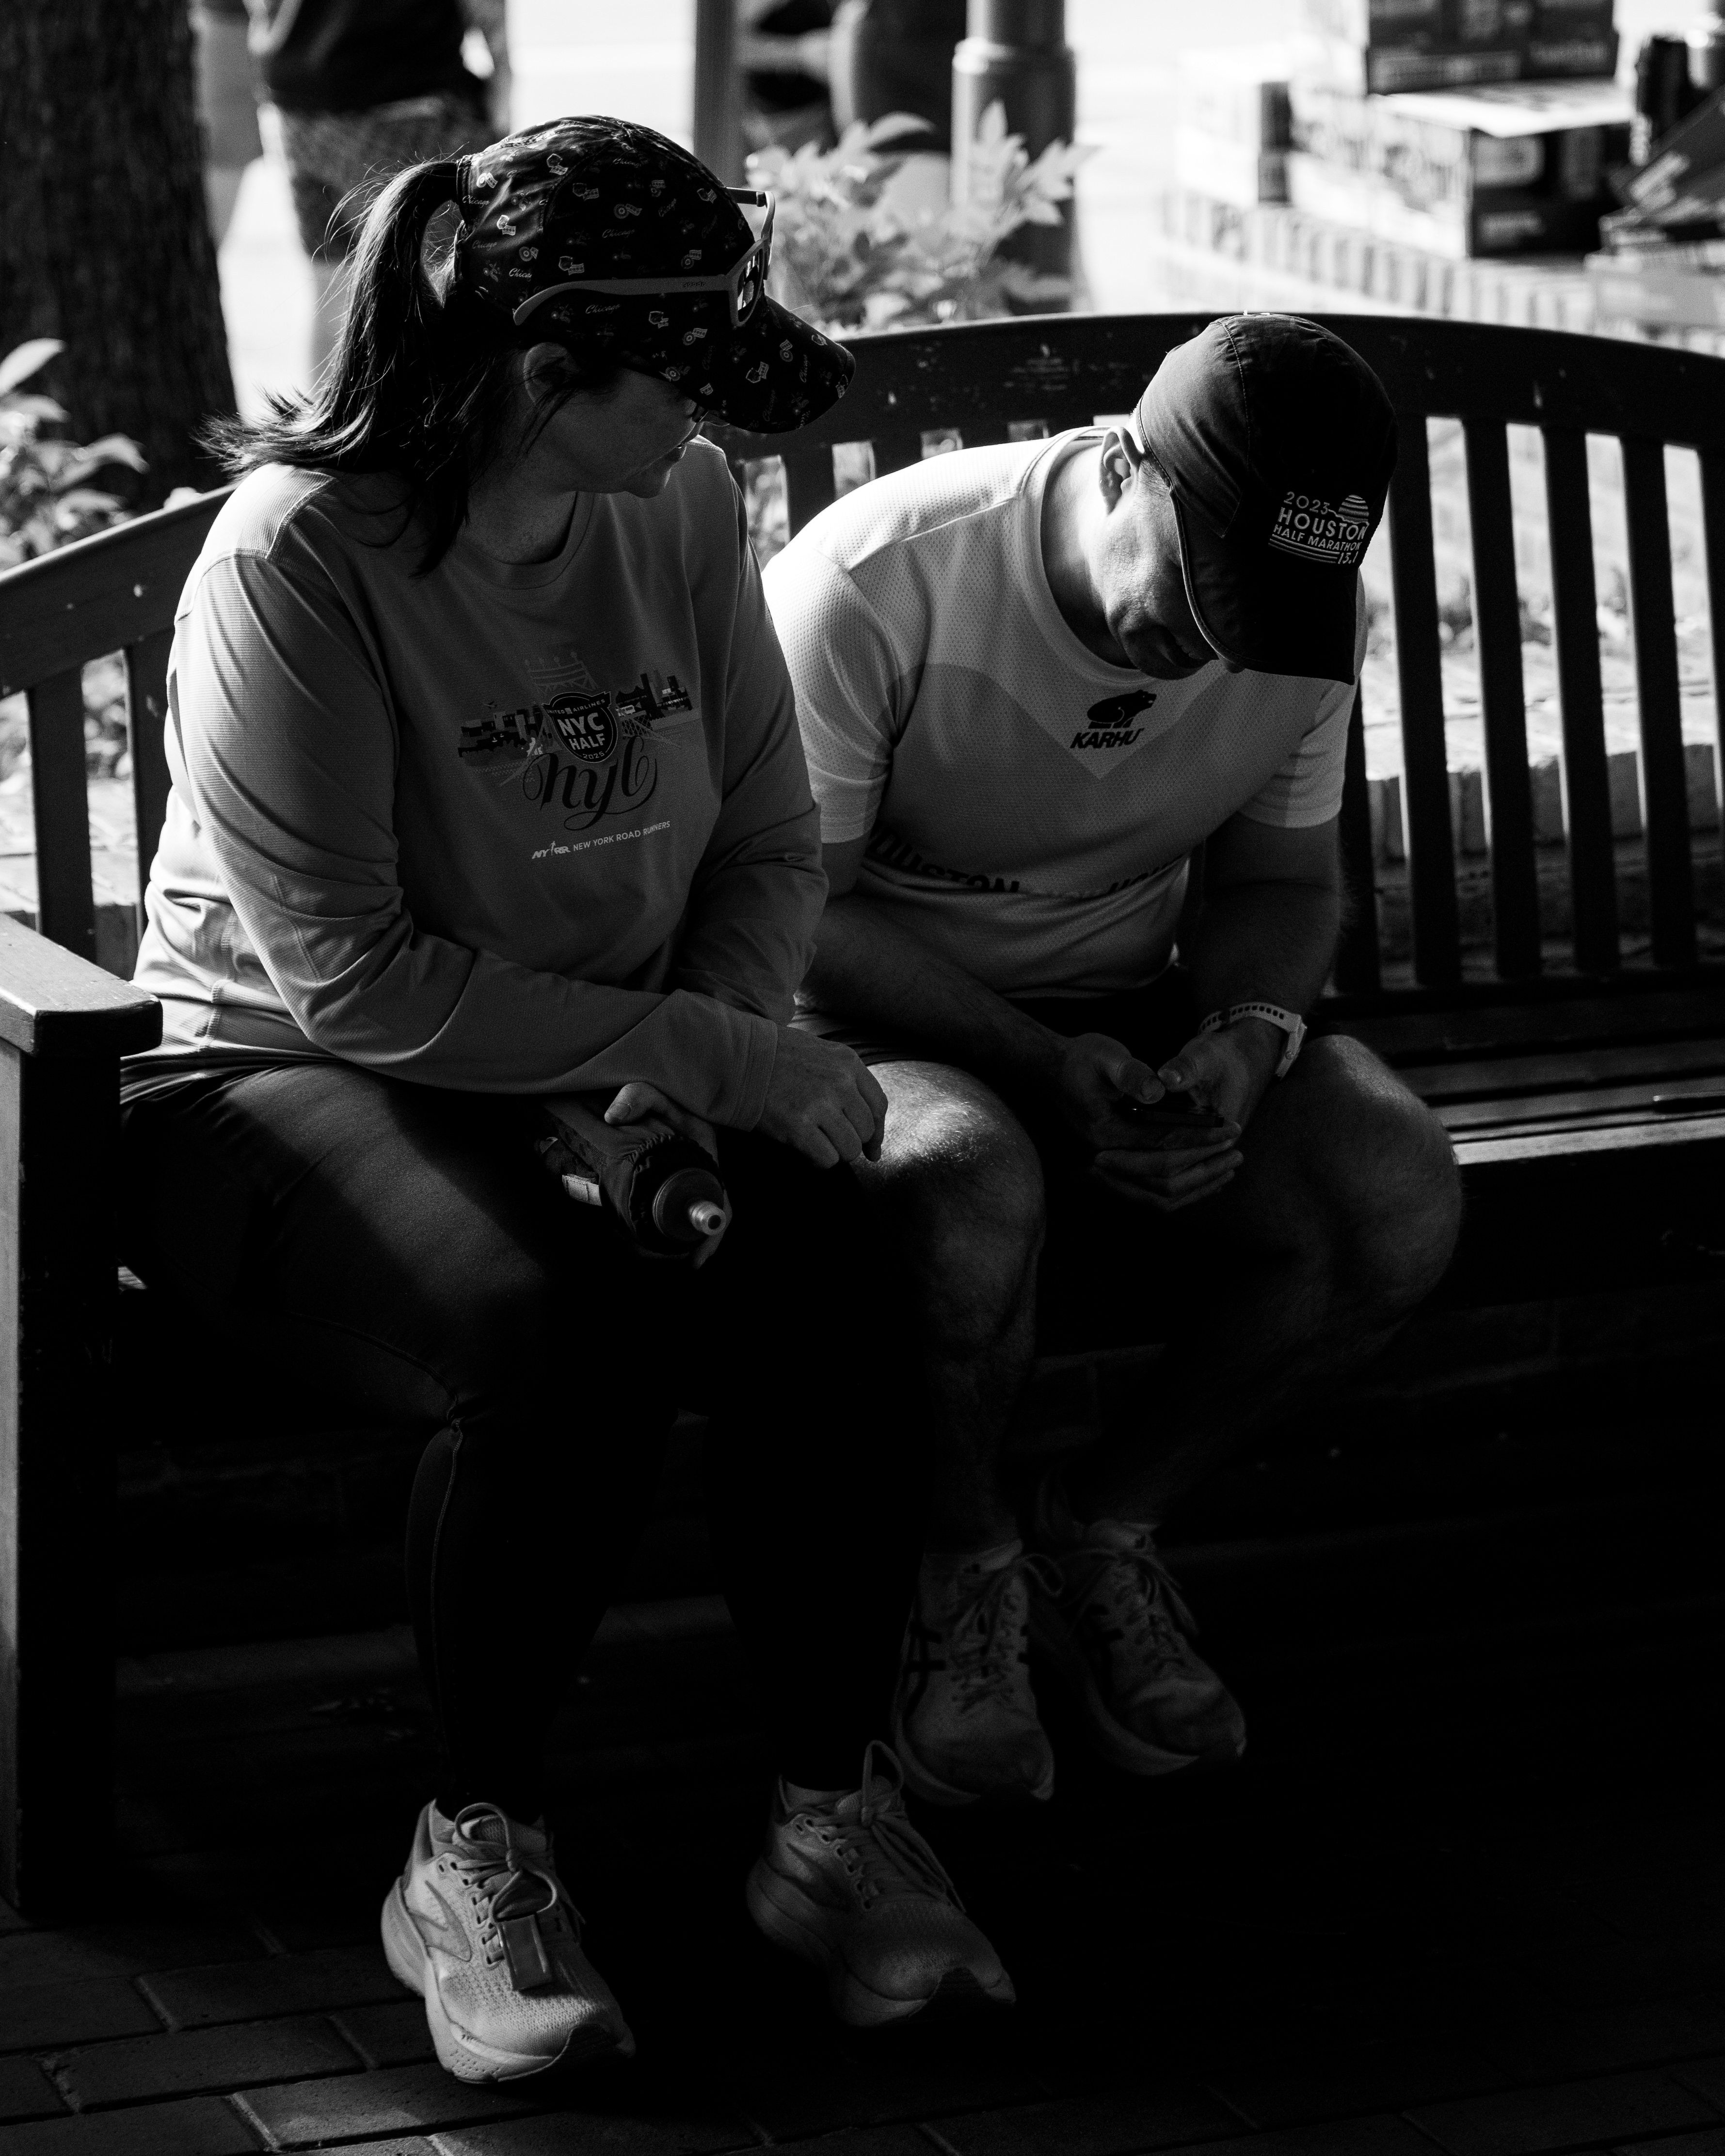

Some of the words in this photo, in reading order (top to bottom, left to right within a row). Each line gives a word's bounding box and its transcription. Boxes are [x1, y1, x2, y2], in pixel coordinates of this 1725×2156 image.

[462, 194, 490, 208] Chicago
[602, 229, 636, 238] Chicago
[509, 268, 533, 282] Chicag
[585, 304, 622, 315] Chicago
[1283, 491, 1330, 515] 2023
[1278, 507, 1367, 540] HOUSTON
[1273, 524, 1305, 541] HALF
[1308, 536, 1363, 551] MARATHON
[1338, 551, 1359, 565] 13.1
[573, 698, 606, 713] AIRLINES
[557, 712, 605, 736] NYC
[568, 733, 606, 750] HALF
[1070, 728, 1145, 748] KARHU
[582, 751, 605, 760] 2025
[573, 840, 591, 851] NEW
[593, 835, 614, 846] YORK
[616, 830, 641, 841] ROAD
[643, 821, 670, 836] RUNNERS
[869, 818, 1019, 893] OUTO
